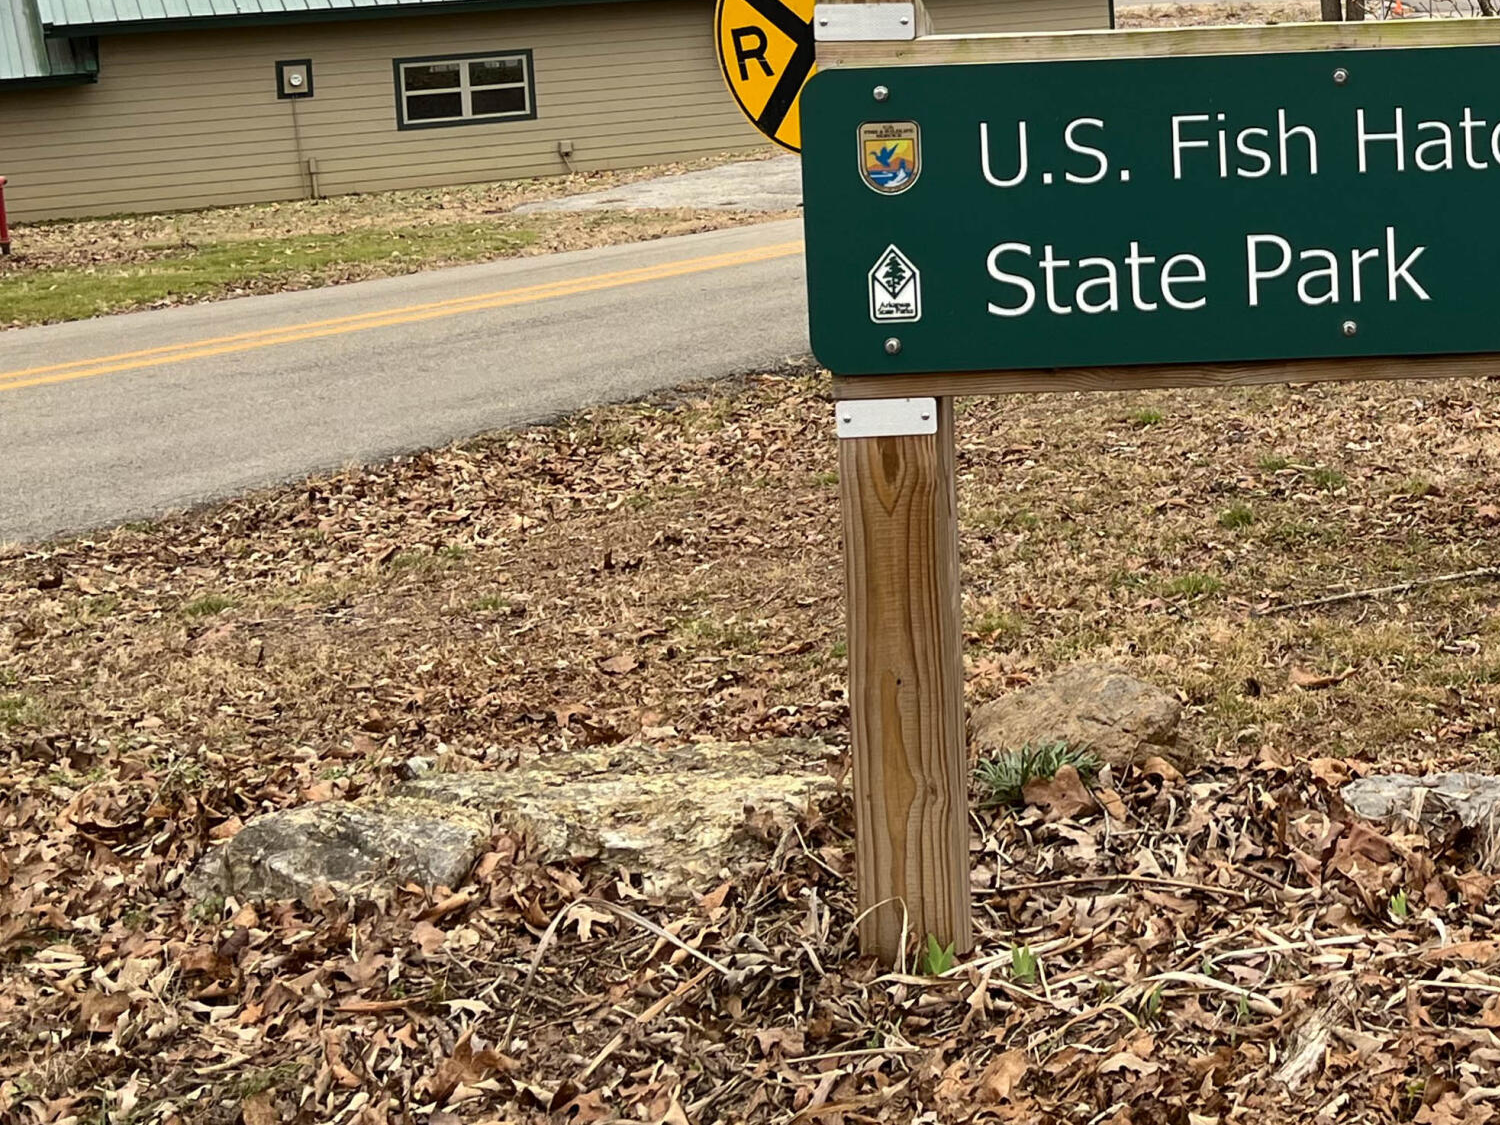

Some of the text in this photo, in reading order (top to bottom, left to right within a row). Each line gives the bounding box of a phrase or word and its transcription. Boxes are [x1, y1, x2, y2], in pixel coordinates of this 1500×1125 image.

[731, 25, 775, 82] R
[979, 119, 1131, 188] U.S.
[1171, 107, 1319, 180] Fish
[985, 225, 1432, 317] State Park
